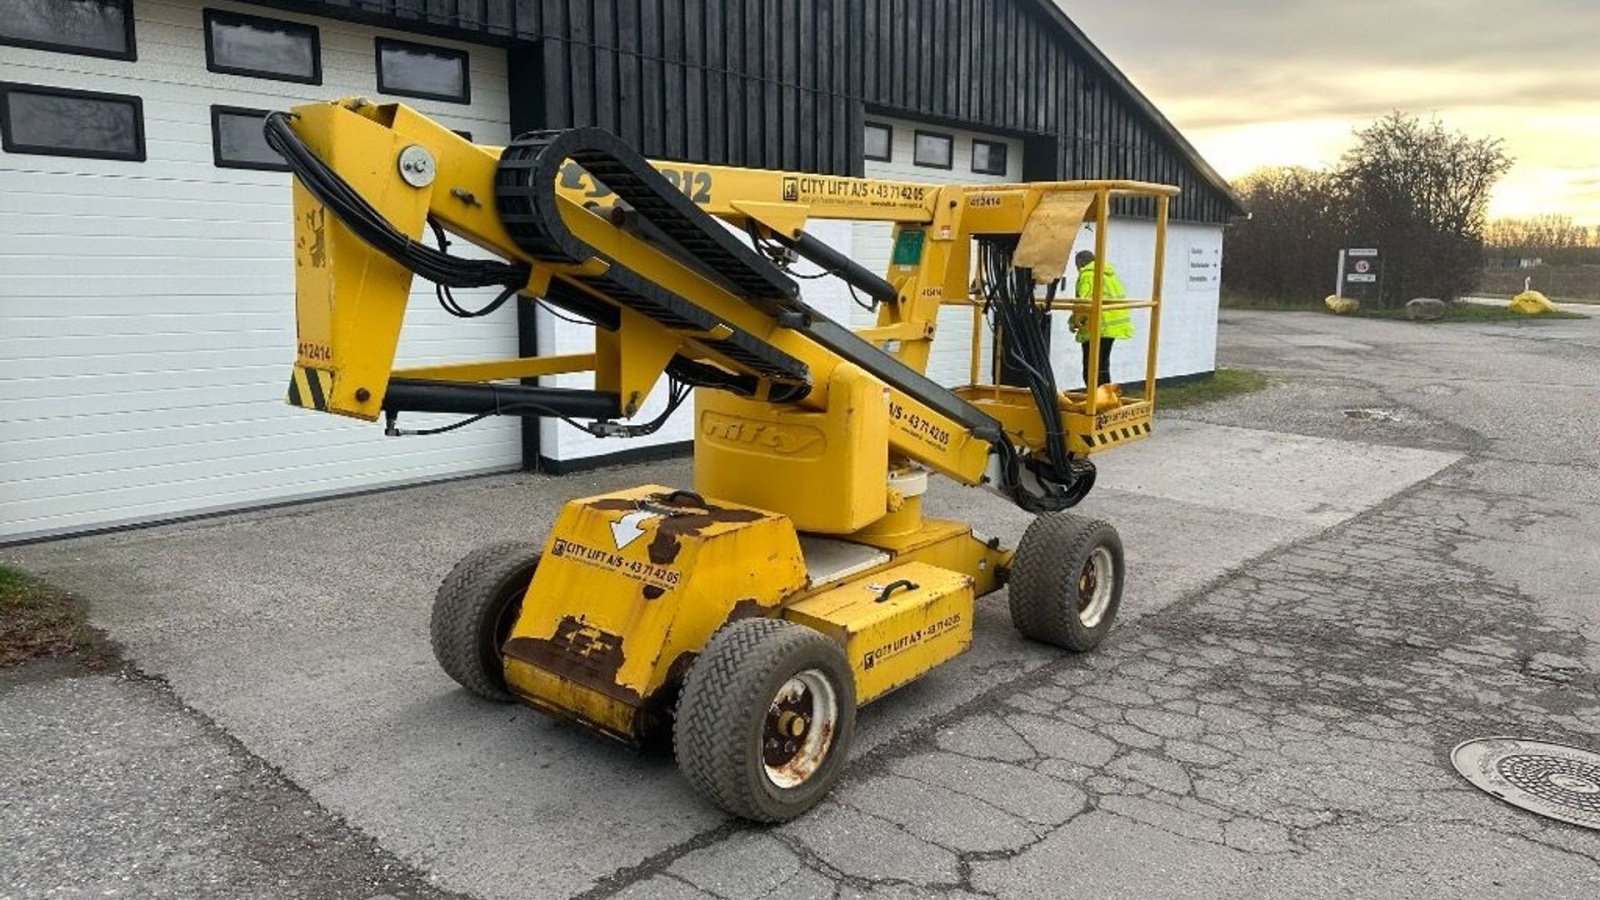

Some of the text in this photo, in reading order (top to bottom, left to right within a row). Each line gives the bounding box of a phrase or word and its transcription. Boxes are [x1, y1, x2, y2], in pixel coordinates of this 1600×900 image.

[800, 178, 923, 201] CITY LIFT A/S 43 71 42 05
[908, 414, 920, 429] 43
[920, 420, 929, 433] 71
[930, 425, 940, 440] 42
[939, 431, 950, 445] 05
[566, 542, 588, 556] CITY
[587, 548, 607, 562] LIFT
[606, 554, 624, 567] A/S
[630, 561, 642, 573] 43
[642, 565, 653, 576] 71
[654, 567, 667, 579] 42
[667, 572, 680, 584] 05
